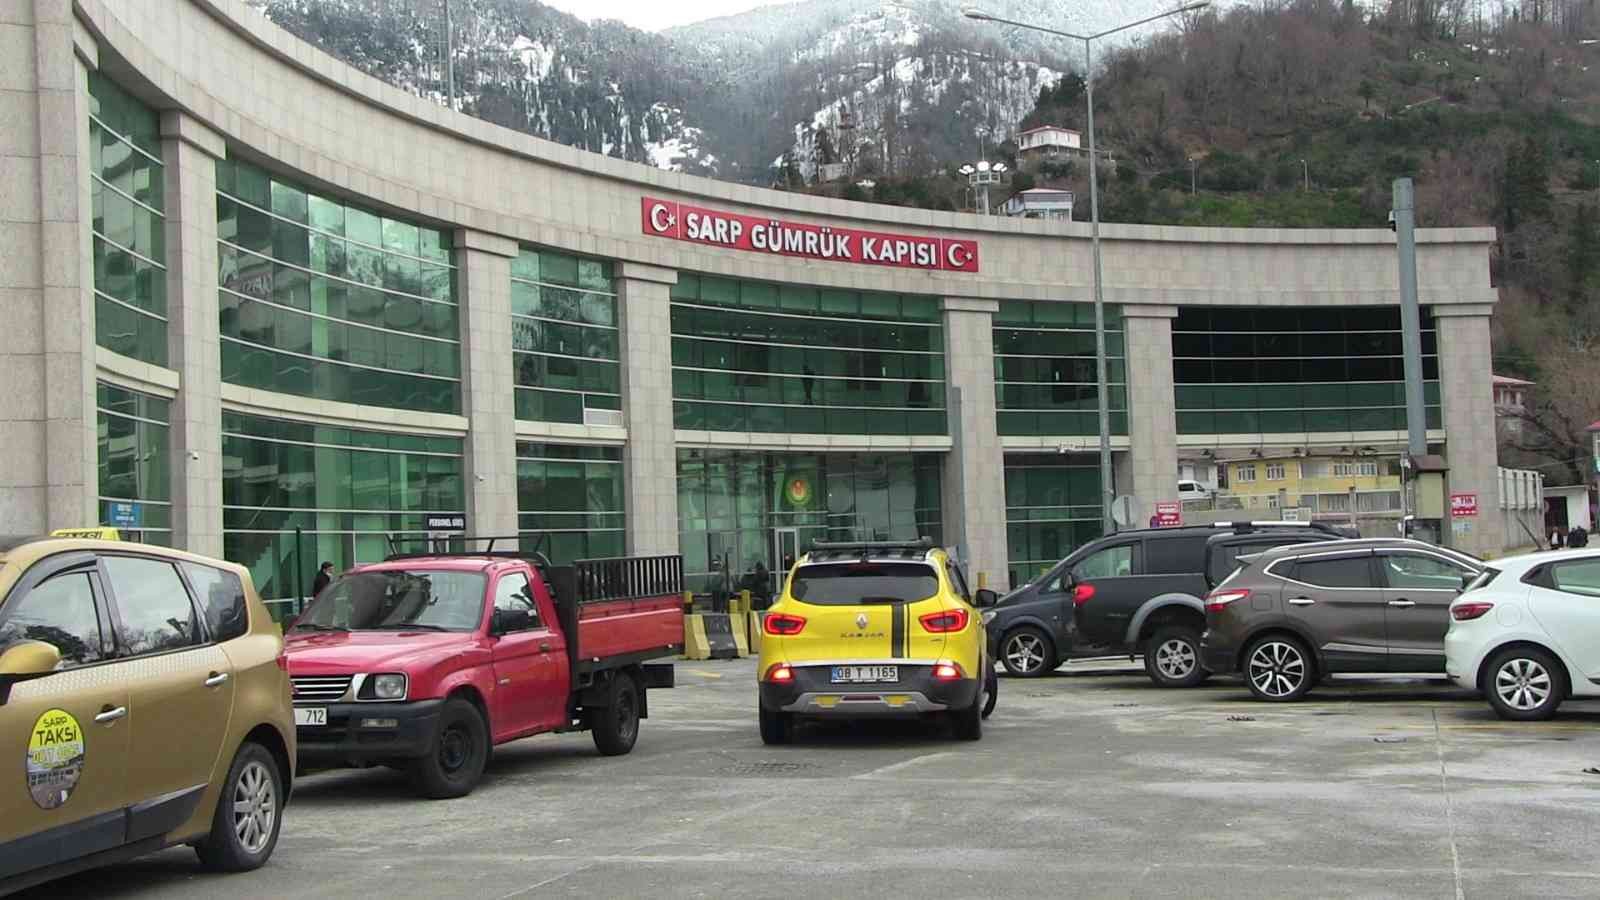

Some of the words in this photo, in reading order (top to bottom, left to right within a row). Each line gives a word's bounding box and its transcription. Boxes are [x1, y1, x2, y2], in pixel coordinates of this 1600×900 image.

[687, 212, 743, 244] SARP
[751, 221, 852, 258] GÜMRÜK
[861, 236, 937, 266] KAPISI
[837, 667, 851, 678] 08
[856, 667, 863, 678] T
[870, 666, 896, 678] 1165
[306, 710, 324, 723] 712
[36, 724, 77, 746] TAKSİ
